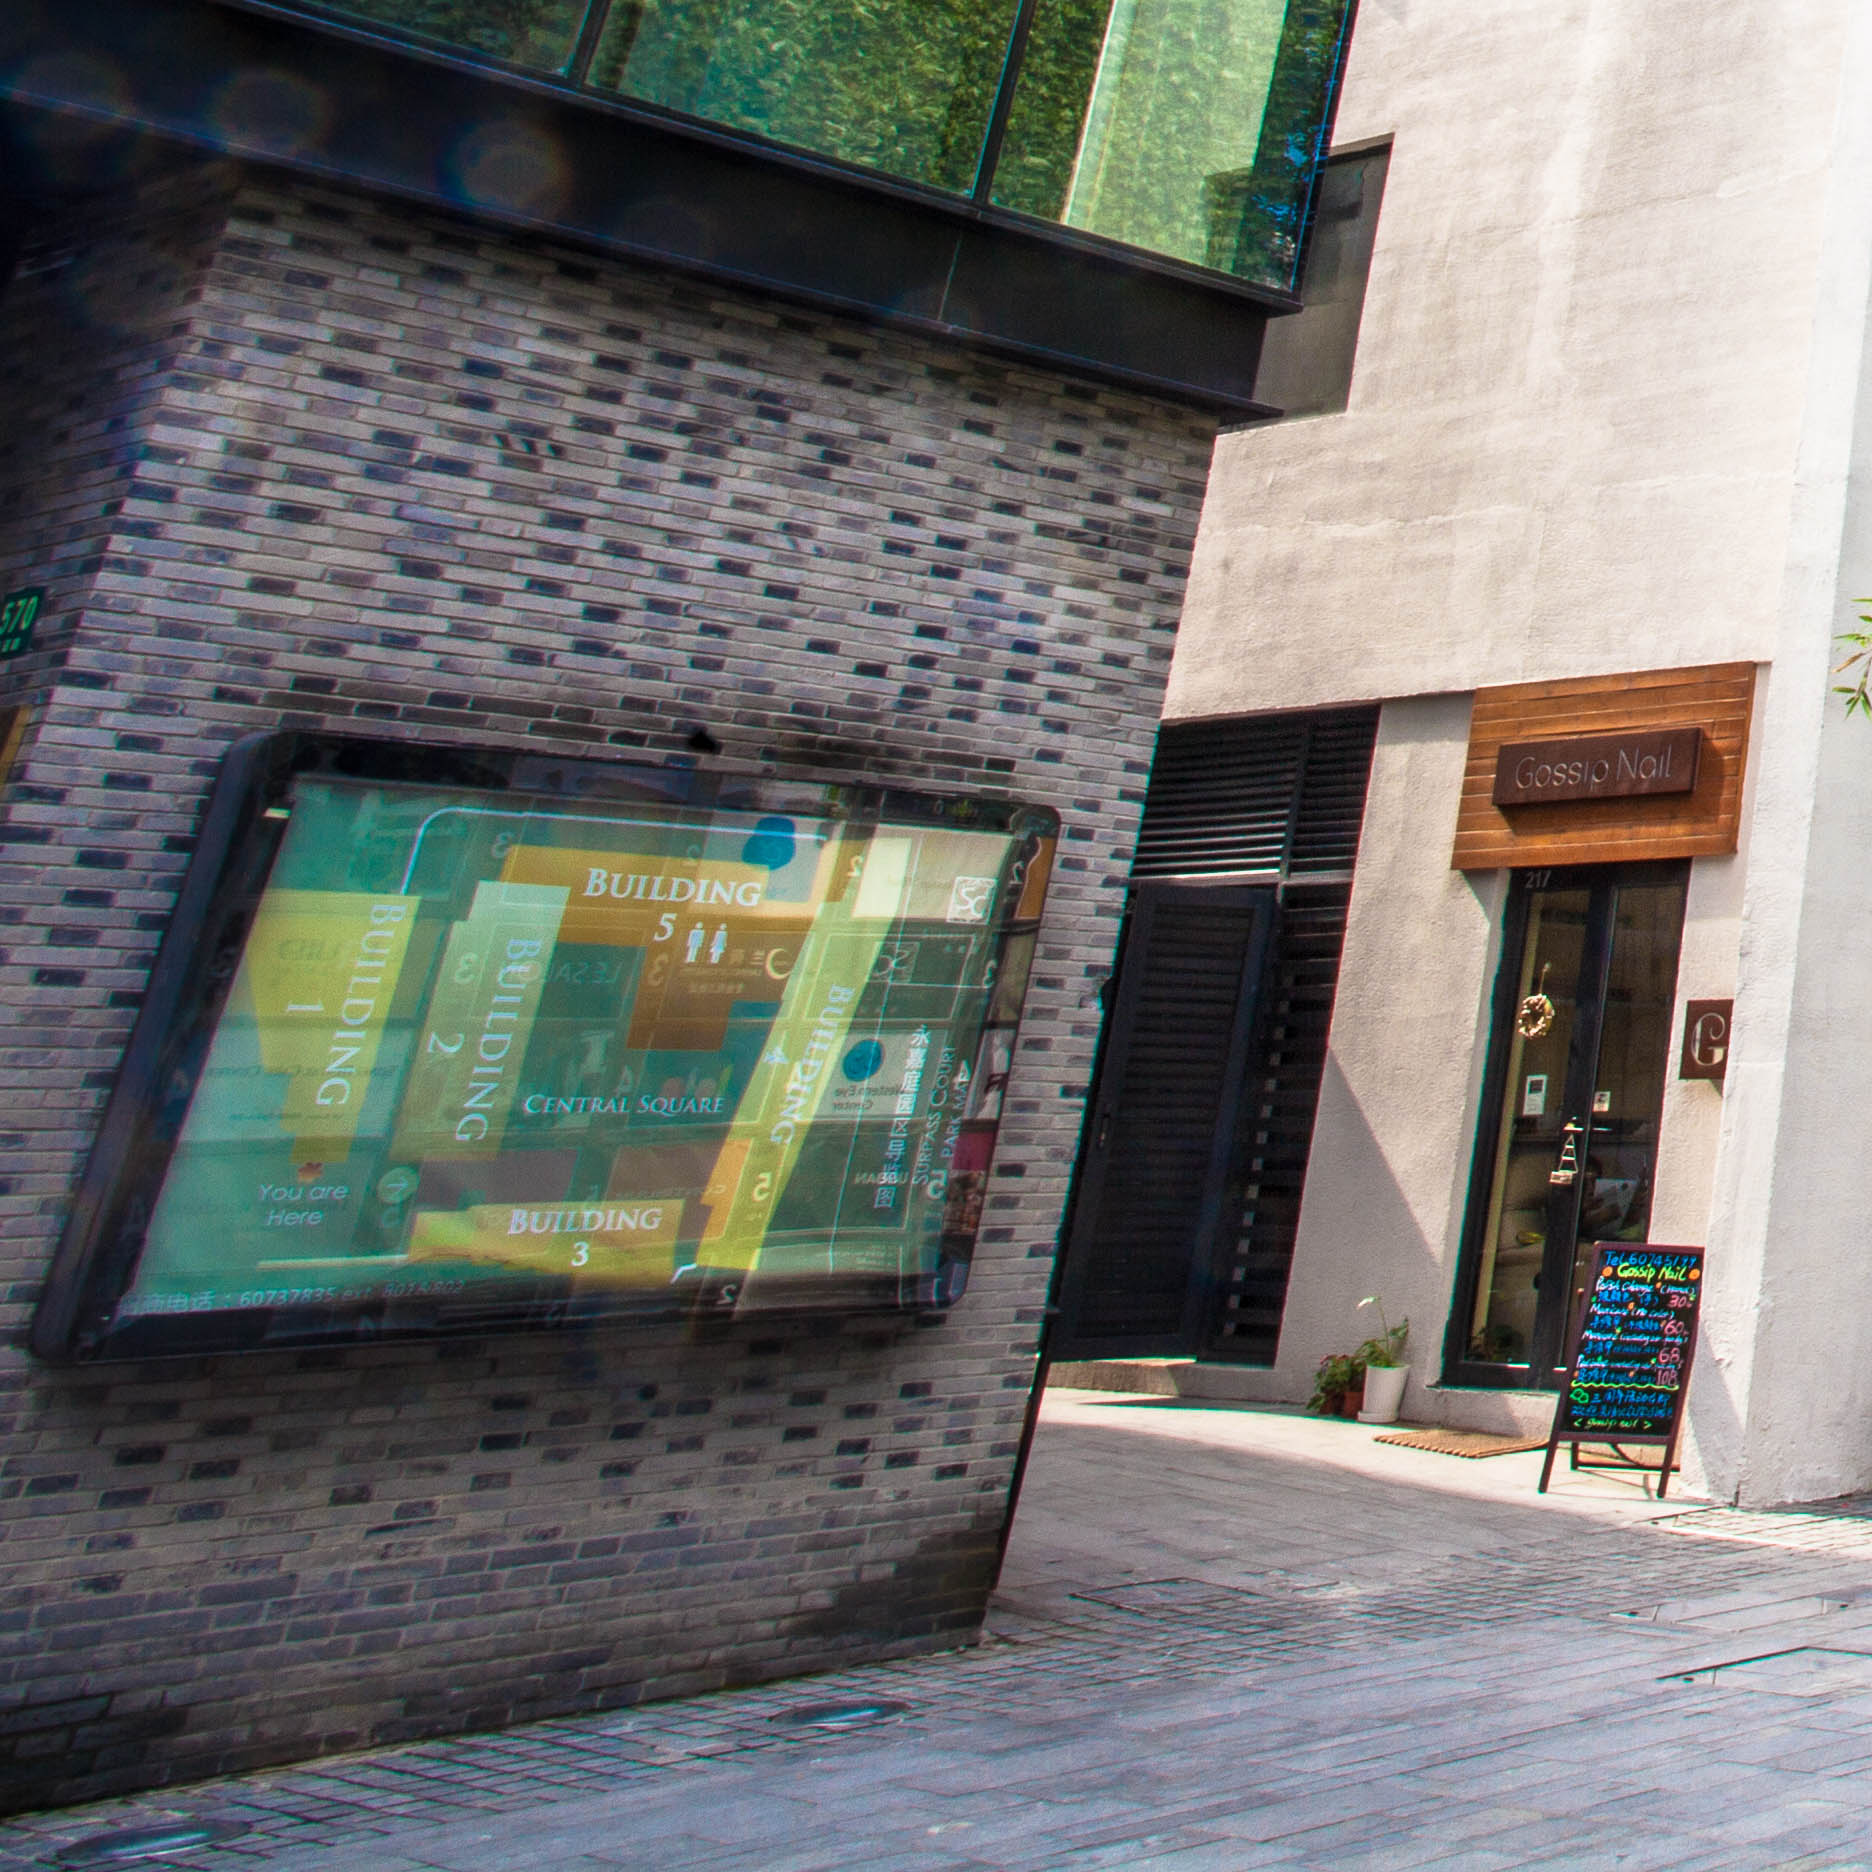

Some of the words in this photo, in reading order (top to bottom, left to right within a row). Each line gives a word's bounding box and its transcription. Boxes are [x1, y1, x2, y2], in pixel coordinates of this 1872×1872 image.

[1514, 755, 1609, 792] Gossip
[1616, 743, 1672, 781] Nail
[584, 867, 763, 907] BUILDING
[653, 912, 677, 942] 5
[285, 1000, 325, 1013] 1
[315, 903, 407, 1107] BUILDING
[427, 1031, 465, 1054] 2
[455, 938, 543, 1143] BUILDING
[1691, 1012, 1727, 1066] G
[769, 983, 856, 1145] BUILDING
[524, 1094, 631, 1113] CENTRAL
[637, 1094, 726, 1117] SQUARE
[259, 1183, 303, 1201] You
[310, 1185, 350, 1201] are
[266, 1208, 323, 1226] Here
[507, 1207, 664, 1235] BUILDING
[571, 1241, 590, 1267] 3
[1617, 1262, 1656, 1283] Gossip
[1658, 1265, 1687, 1281] Nail
